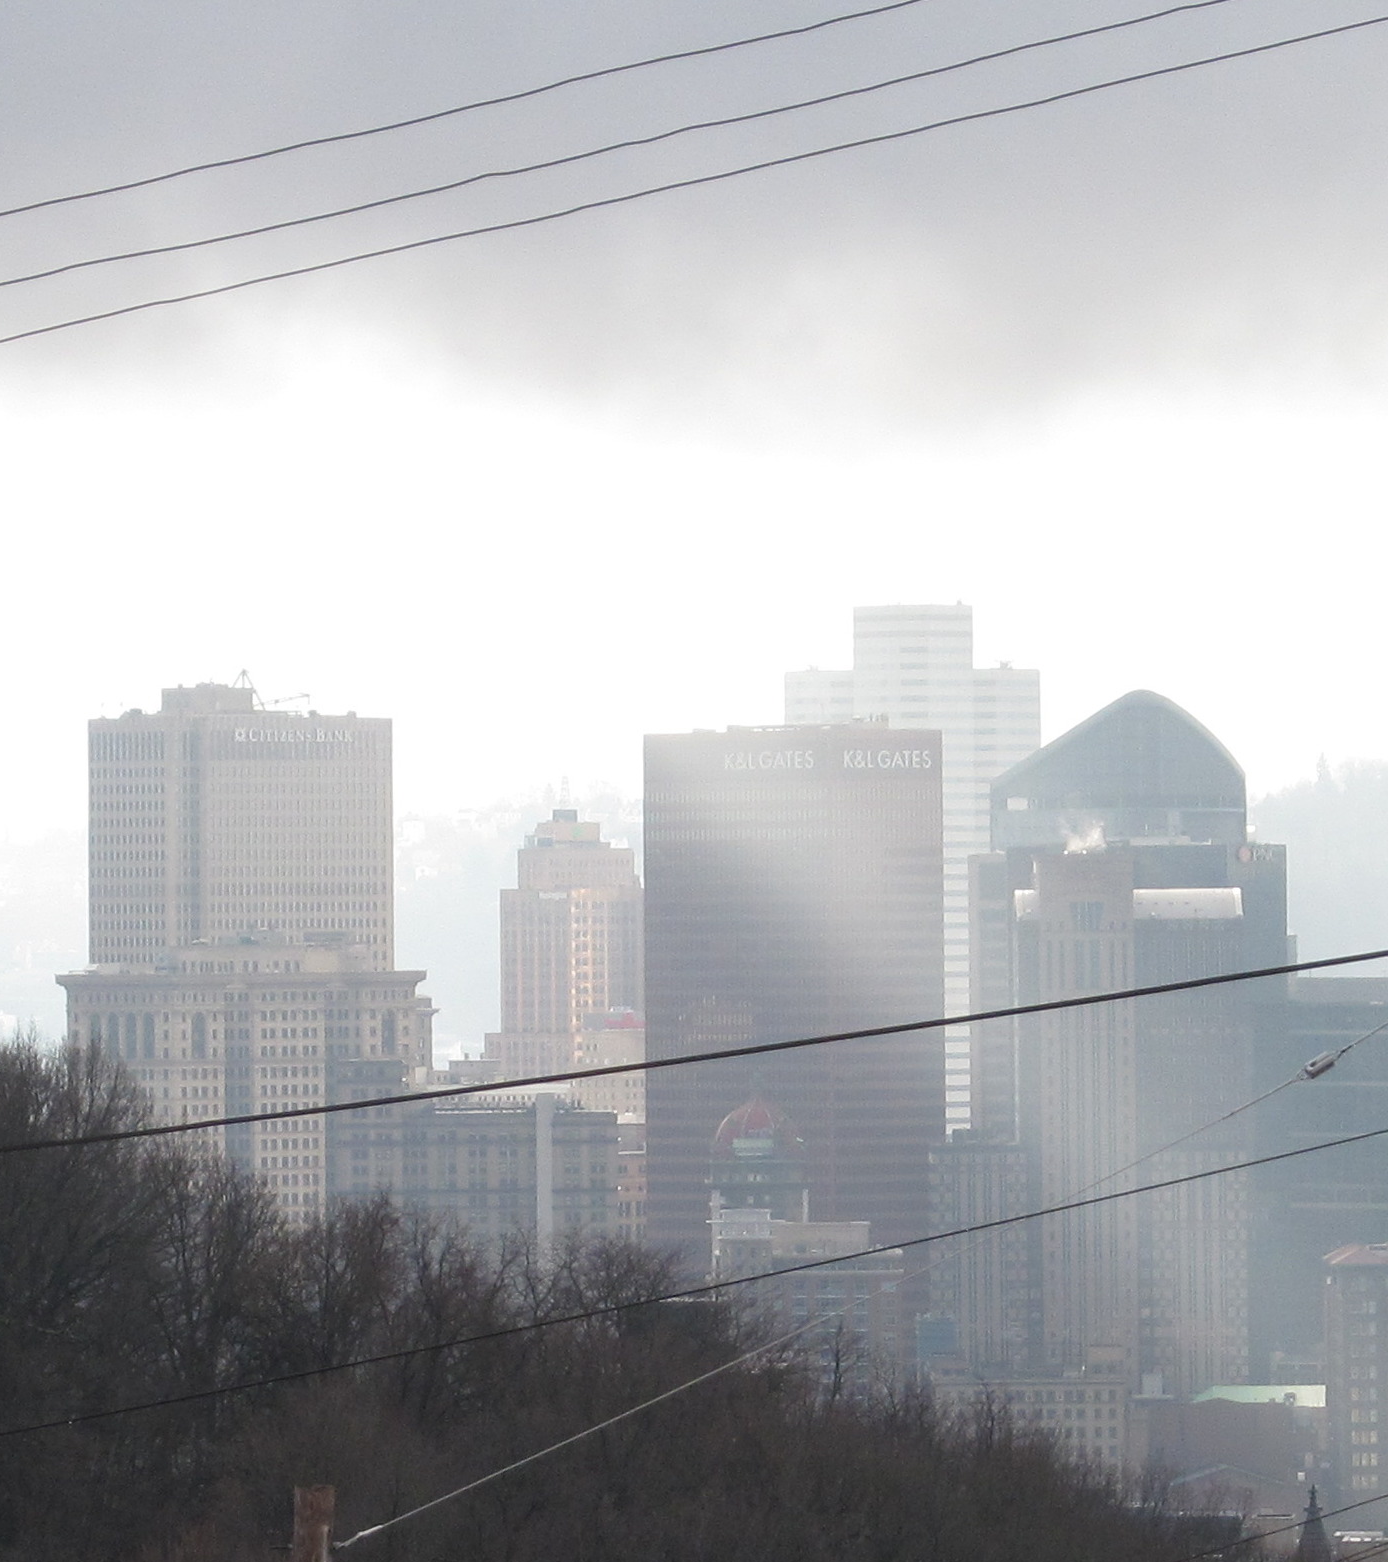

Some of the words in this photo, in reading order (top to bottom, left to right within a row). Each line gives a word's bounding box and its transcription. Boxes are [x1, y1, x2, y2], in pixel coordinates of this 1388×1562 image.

[316, 727, 353, 742] BANK
[724, 751, 755, 769] K&L
[759, 750, 814, 769] GATES
[843, 750, 873, 768] K&L
[877, 750, 931, 768] GATES
